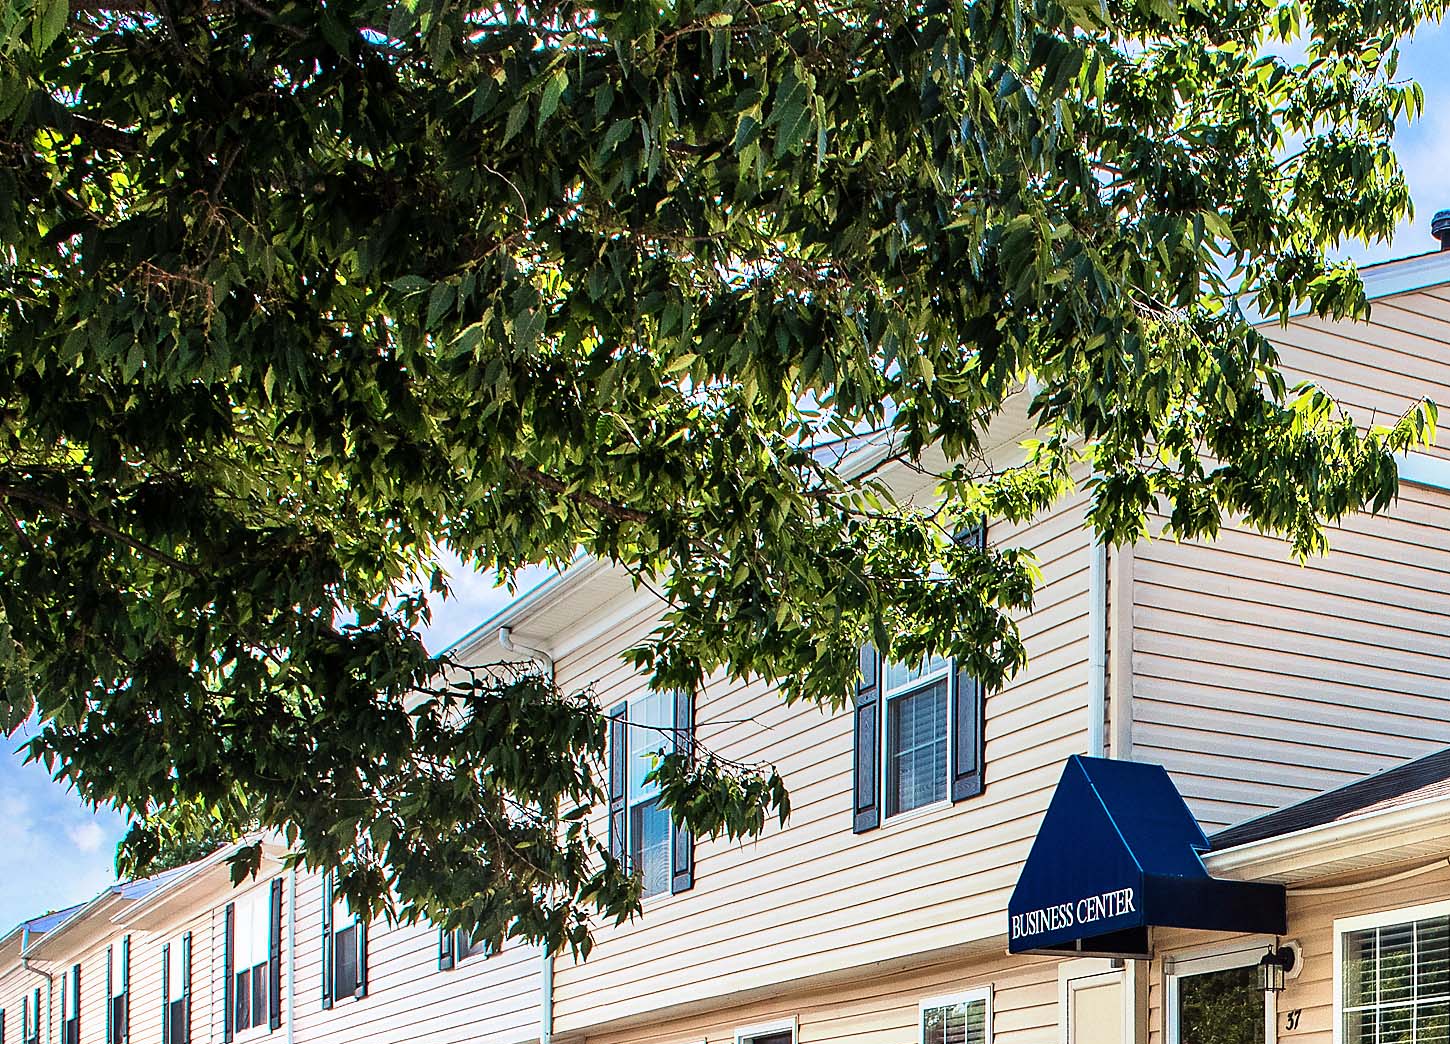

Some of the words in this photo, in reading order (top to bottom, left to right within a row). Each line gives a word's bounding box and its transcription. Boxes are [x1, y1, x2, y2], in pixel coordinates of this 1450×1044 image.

[1011, 902, 1074, 940] BUSINESS
[1076, 887, 1136, 925] CENTER
[1285, 1008, 1302, 1031] 37
